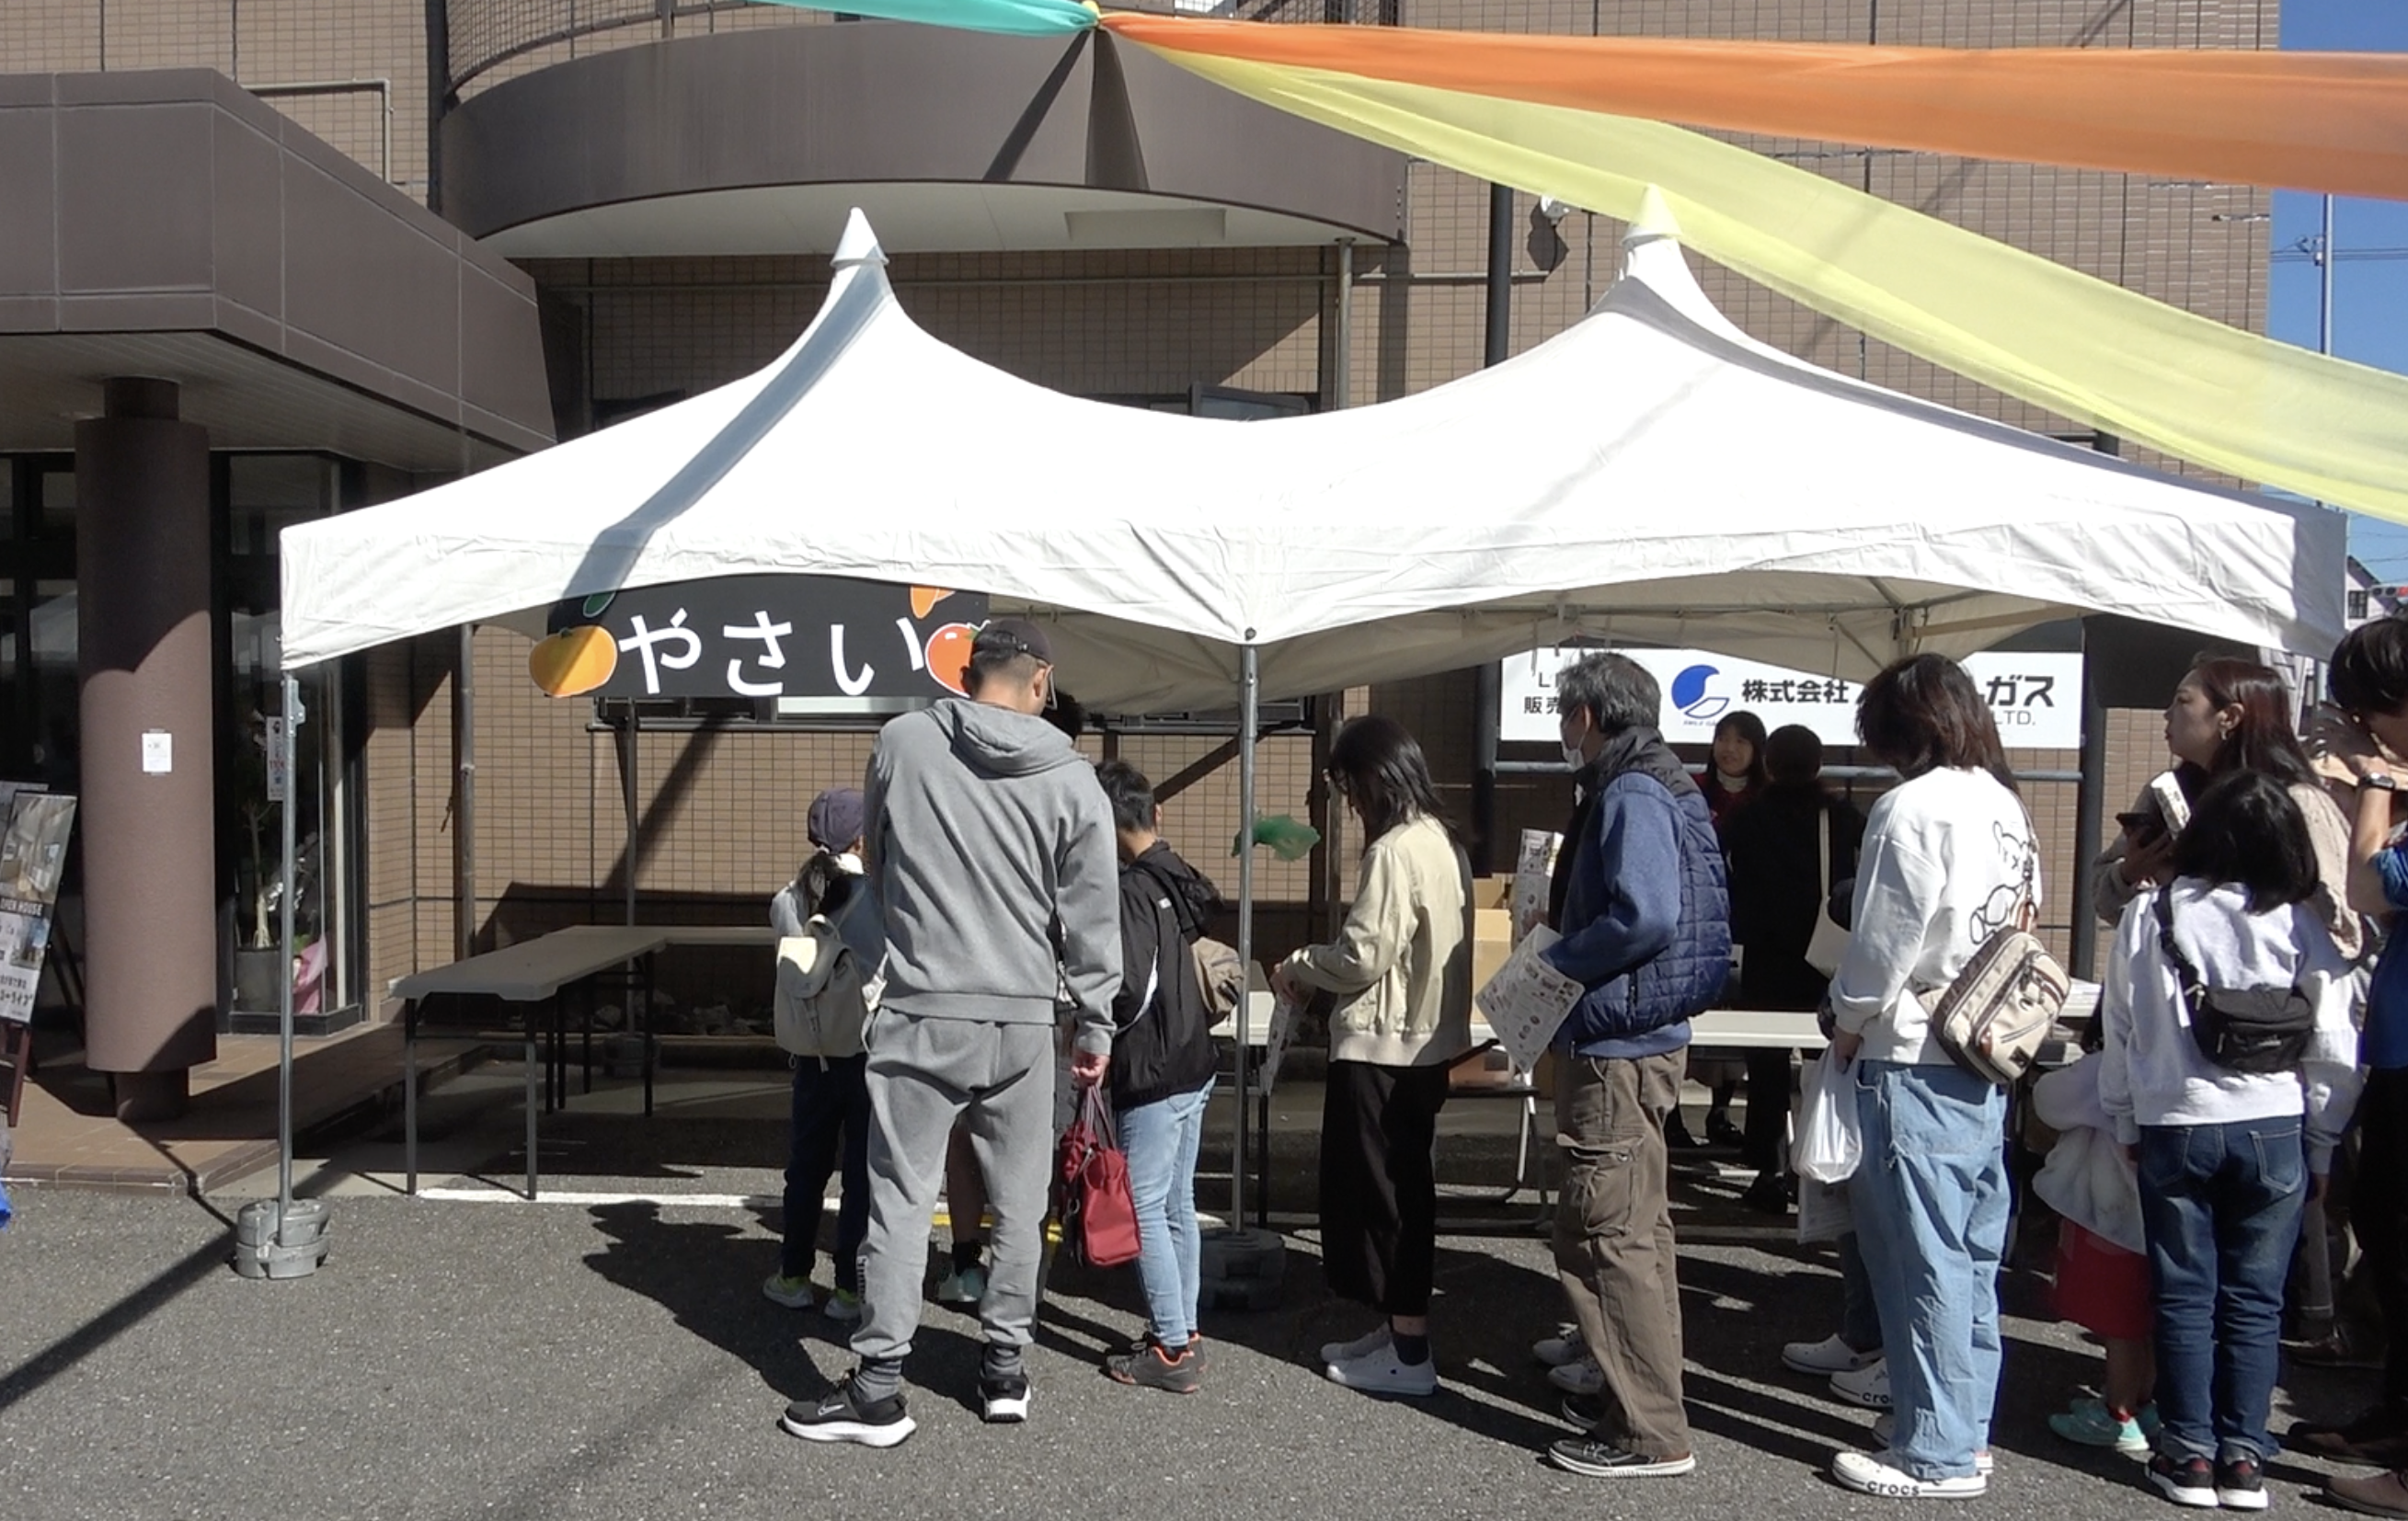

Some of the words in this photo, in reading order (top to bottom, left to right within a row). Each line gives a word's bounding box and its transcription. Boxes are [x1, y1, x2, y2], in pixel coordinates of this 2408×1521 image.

[618, 608, 923, 696] やさい
[1741, 679, 1849, 704] 株式会社
[1862, 1391, 1894, 1404] cro
[1866, 1481, 1921, 1496] crocs
